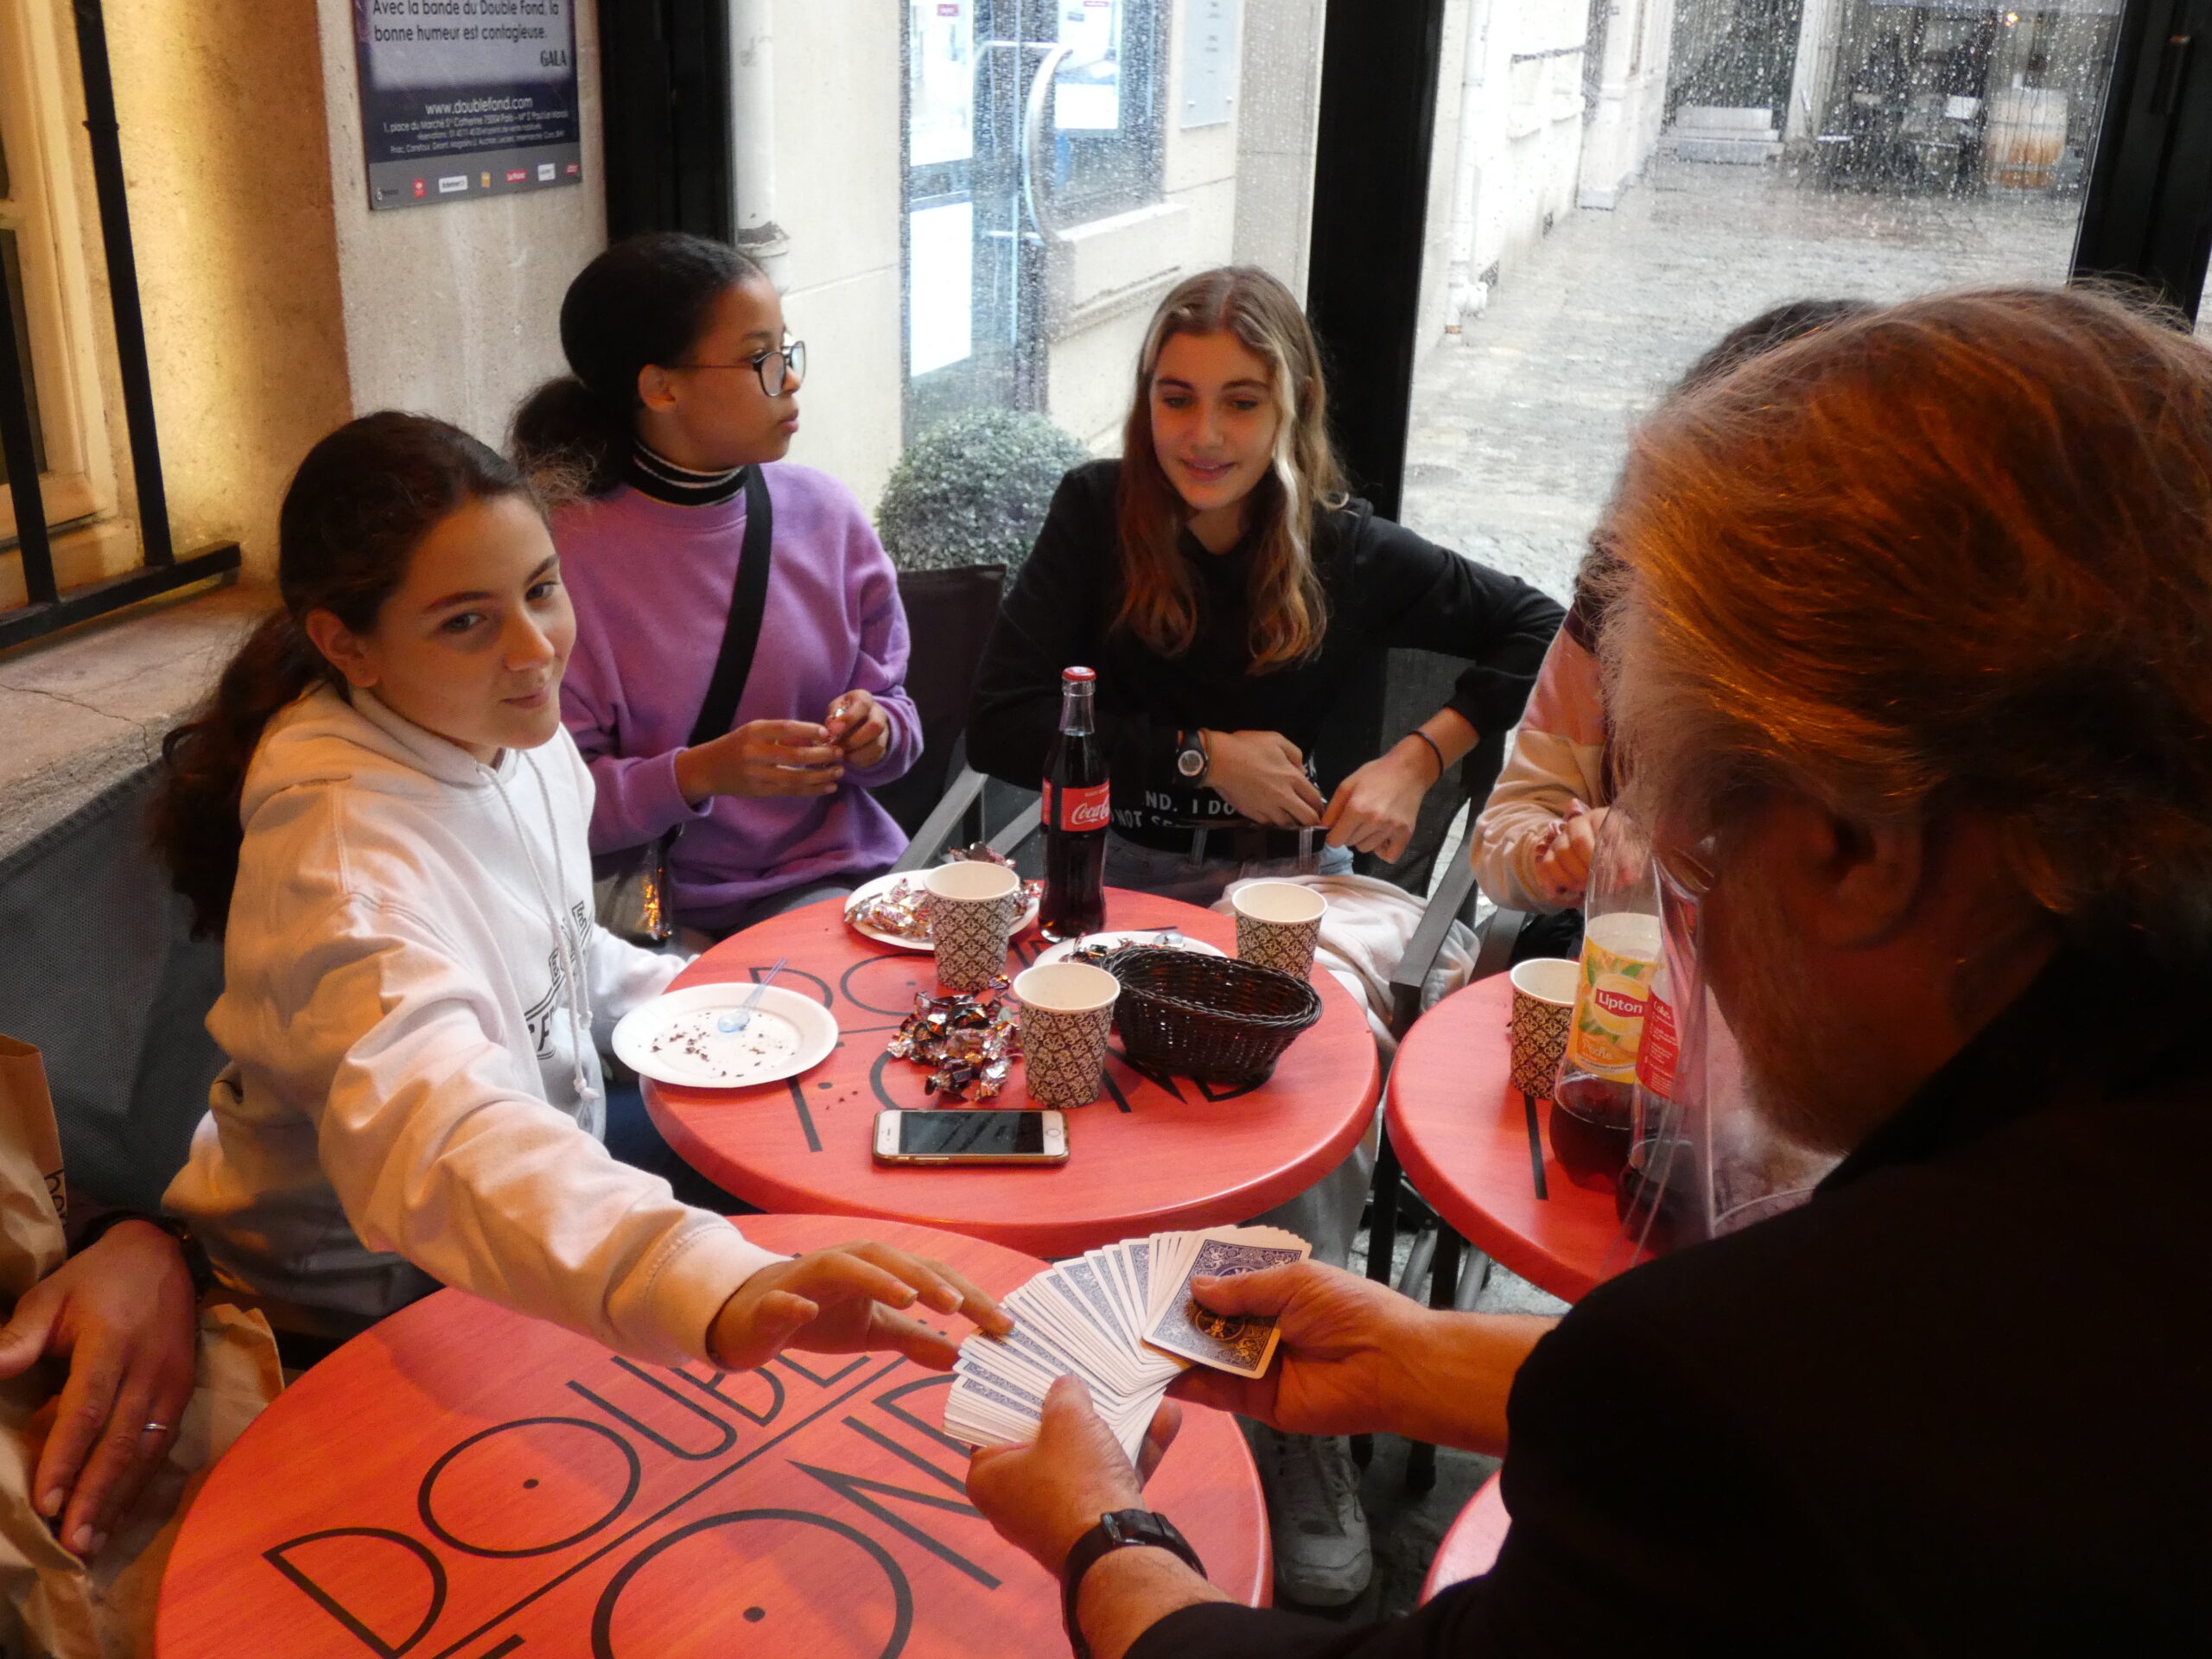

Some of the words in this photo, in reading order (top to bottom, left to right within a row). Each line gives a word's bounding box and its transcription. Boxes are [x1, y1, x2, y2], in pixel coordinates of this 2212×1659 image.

[373, 0, 404, 15] Avec
[408, 0, 420, 15] la
[423, 0, 460, 15] bande
[463, 0, 477, 15] du
[480, 0, 518, 15] Double
[550, 0, 559, 15] la
[374, 24, 414, 41] bonne
[416, 24, 460, 41] humeur
[463, 24, 479, 40] est
[481, 23, 547, 43] contagieuse.
[540, 50, 567, 67] GALA
[424, 97, 533, 115] www.doublefond.com
[1192, 799, 1198, 814] I
[1599, 992, 1643, 1014] Lipton
